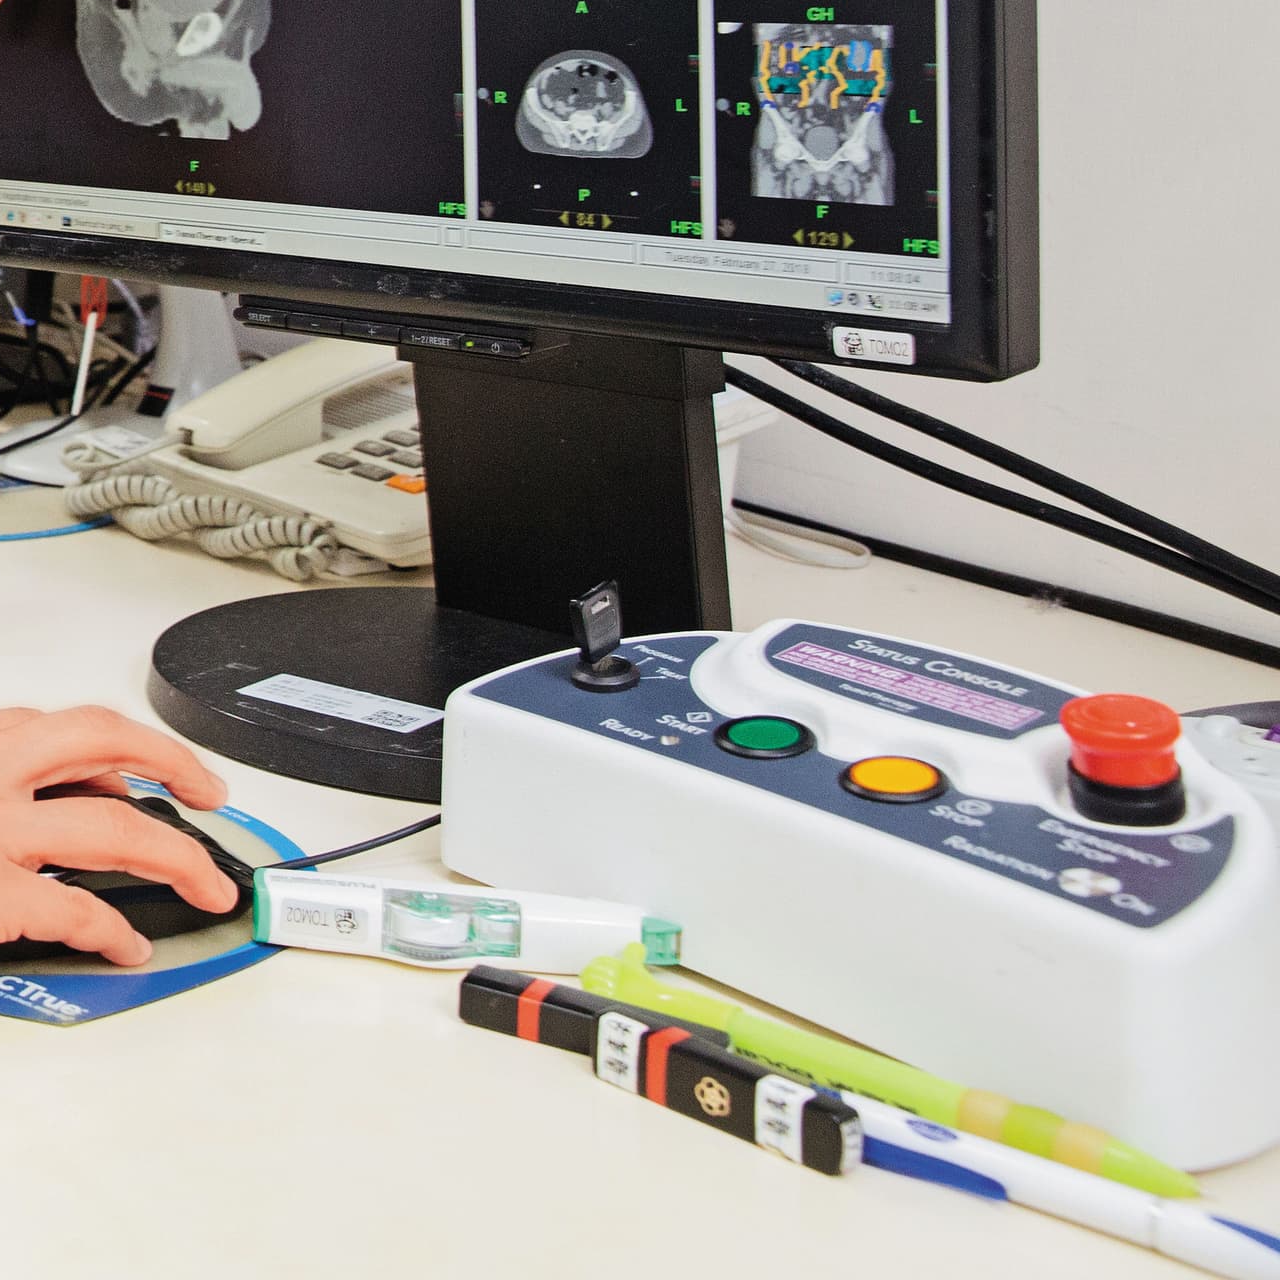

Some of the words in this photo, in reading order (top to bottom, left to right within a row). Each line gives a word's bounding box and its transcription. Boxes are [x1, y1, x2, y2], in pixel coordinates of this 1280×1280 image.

[576, 1, 589, 13] A
[806, 7, 835, 21] GH
[494, 91, 508, 104] R
[675, 99, 688, 112] L
[736, 102, 751, 116] R
[909, 109, 923, 124] L
[190, 160, 199, 172] F
[578, 189, 591, 202] P
[439, 202, 467, 216] HFS
[816, 205, 829, 219] F
[671, 220, 702, 235] HFS
[903, 239, 941, 255] HFS
[248, 312, 271, 323] SELECT
[869, 338, 910, 357] TOMO2
[848, 639, 920, 665] STATUS
[924, 660, 1030, 697] CONSOLE
[599, 718, 656, 740] READY
[656, 714, 709, 735] START
[928, 805, 985, 827] STOP
[1038, 818, 1171, 867] EMERGENCY
[1056, 837, 1118, 863] STOP
[943, 835, 1055, 881] RADIATION
[1110, 892, 1156, 916] ON
[287, 906, 329, 928] TOMO2
